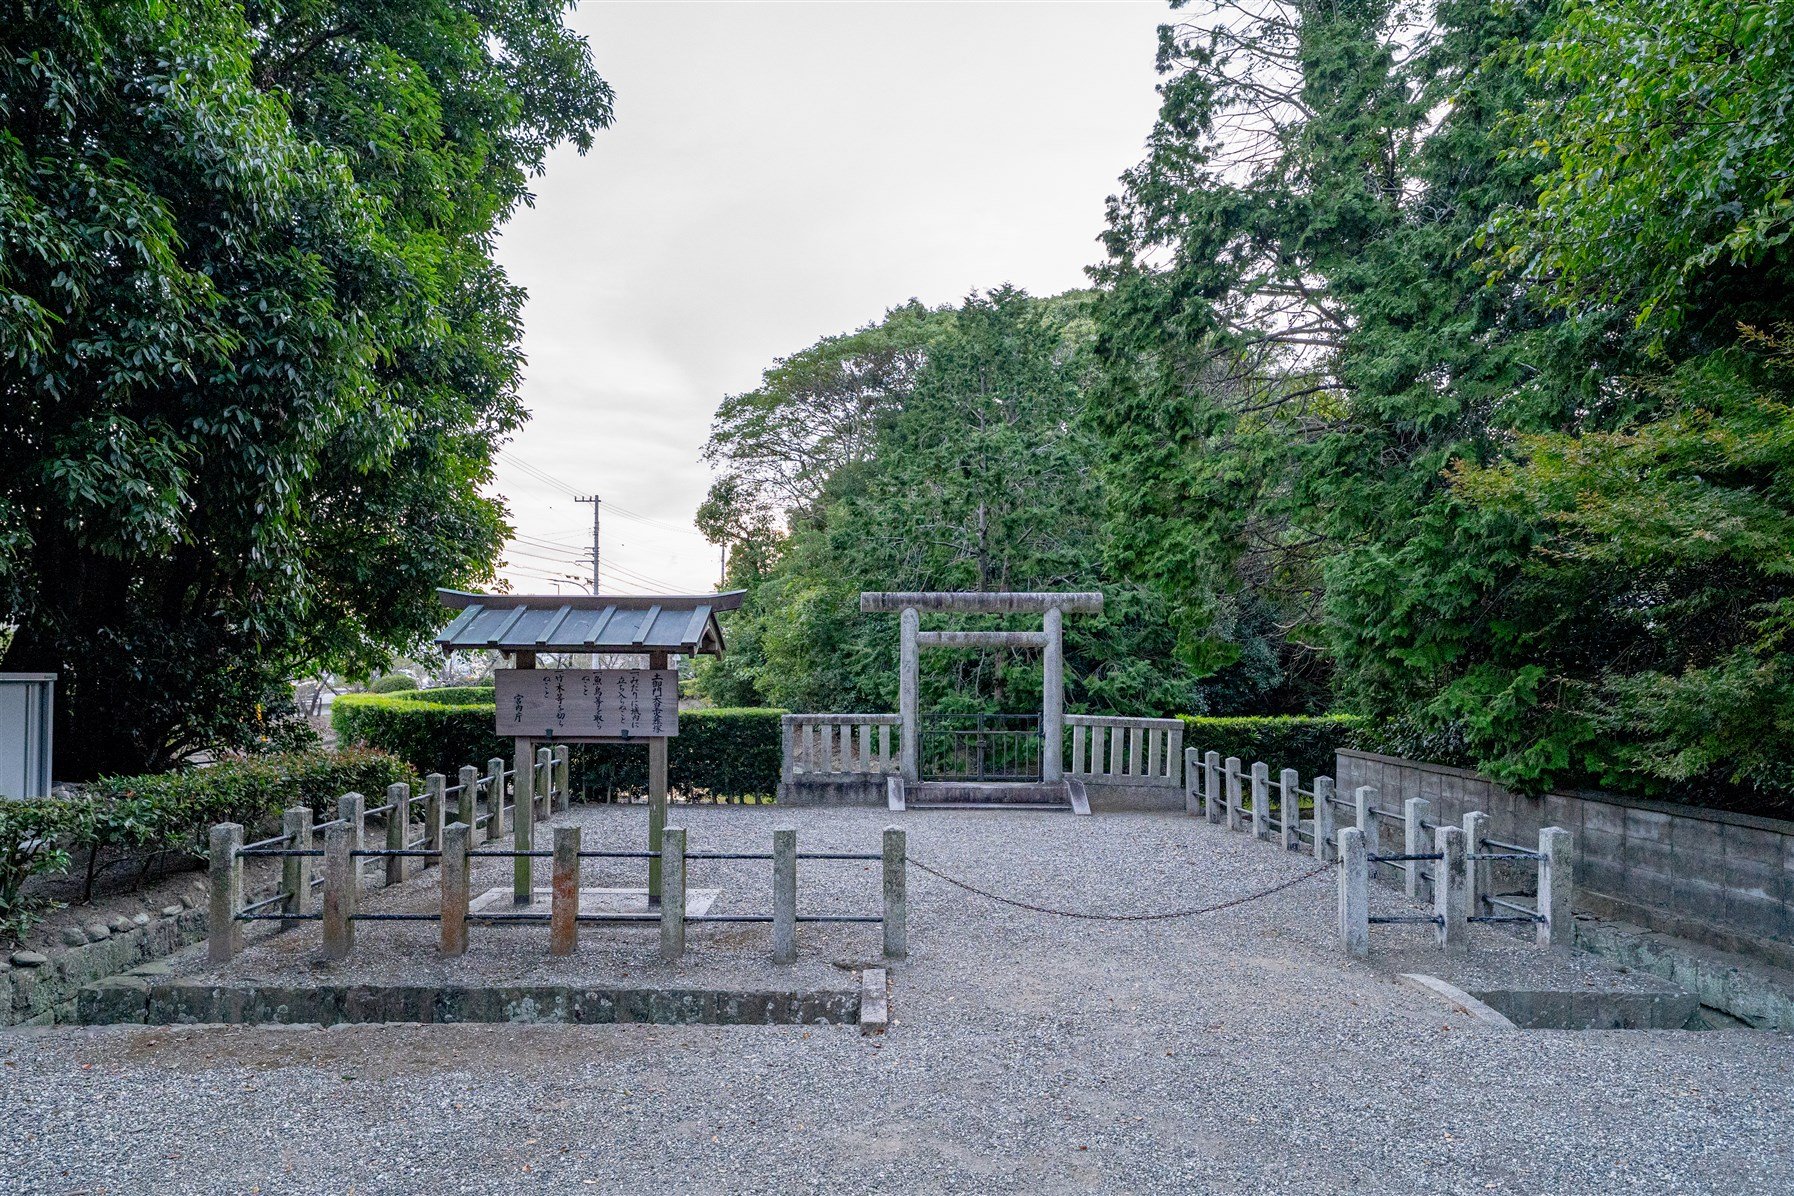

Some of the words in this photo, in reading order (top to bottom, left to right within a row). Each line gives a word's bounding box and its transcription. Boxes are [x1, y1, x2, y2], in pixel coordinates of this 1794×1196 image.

[543, 676, 551, 699] ぬこと
[582, 676, 590, 696] ぬこと
[513, 693, 524, 722] 宮内庁
[617, 676, 627, 724] 立ち入らぬこと
